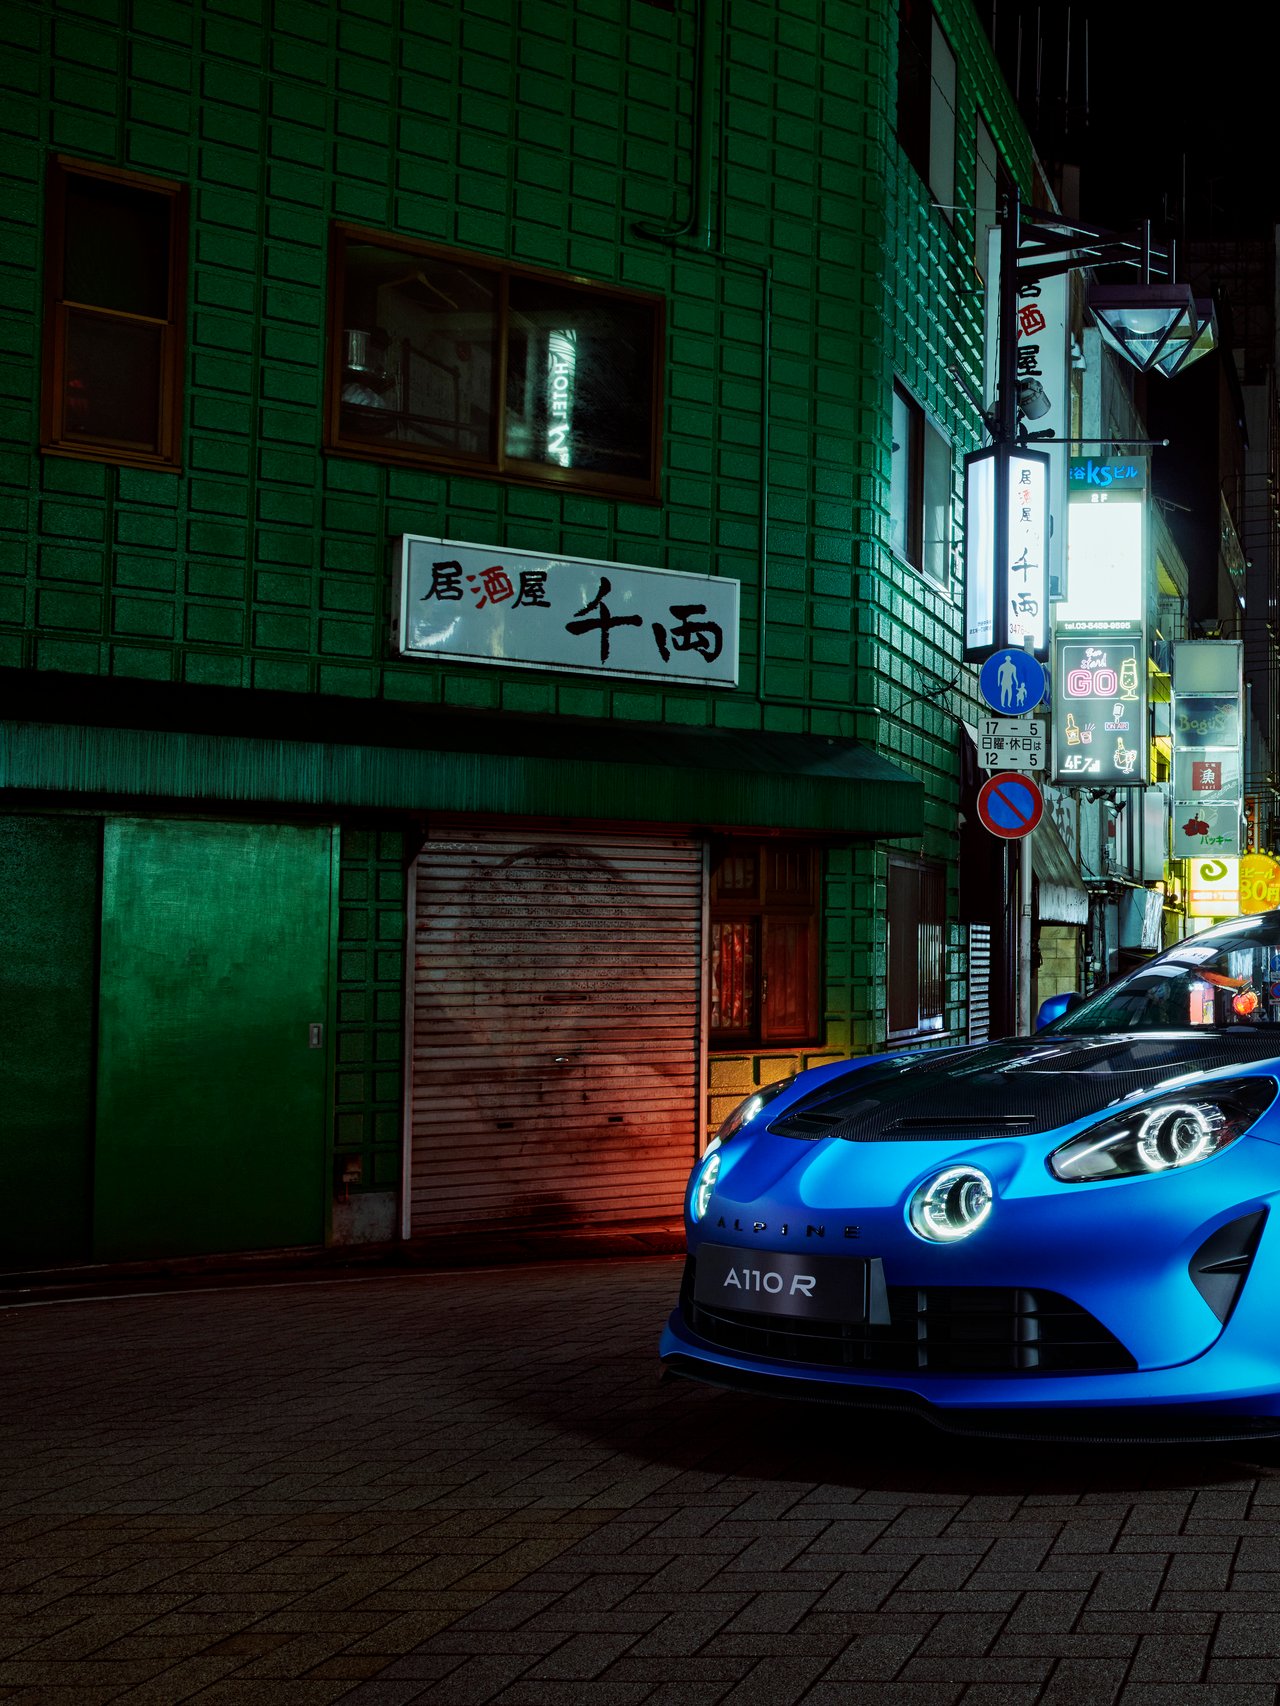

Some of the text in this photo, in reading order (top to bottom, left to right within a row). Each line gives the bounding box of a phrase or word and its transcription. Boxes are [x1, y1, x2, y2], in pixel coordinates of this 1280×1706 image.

[420, 560, 724, 665] 居酒屋 千両
[1067, 669, 1117, 696] GO
[986, 722, 998, 735] 17
[1029, 723, 1038, 736] 5
[985, 752, 998, 765] 12
[1029, 753, 1037, 766] 5
[1064, 755, 1083, 770] 4F
[716, 1215, 863, 1239] ALPINE
[789, 1274, 817, 1297] R
